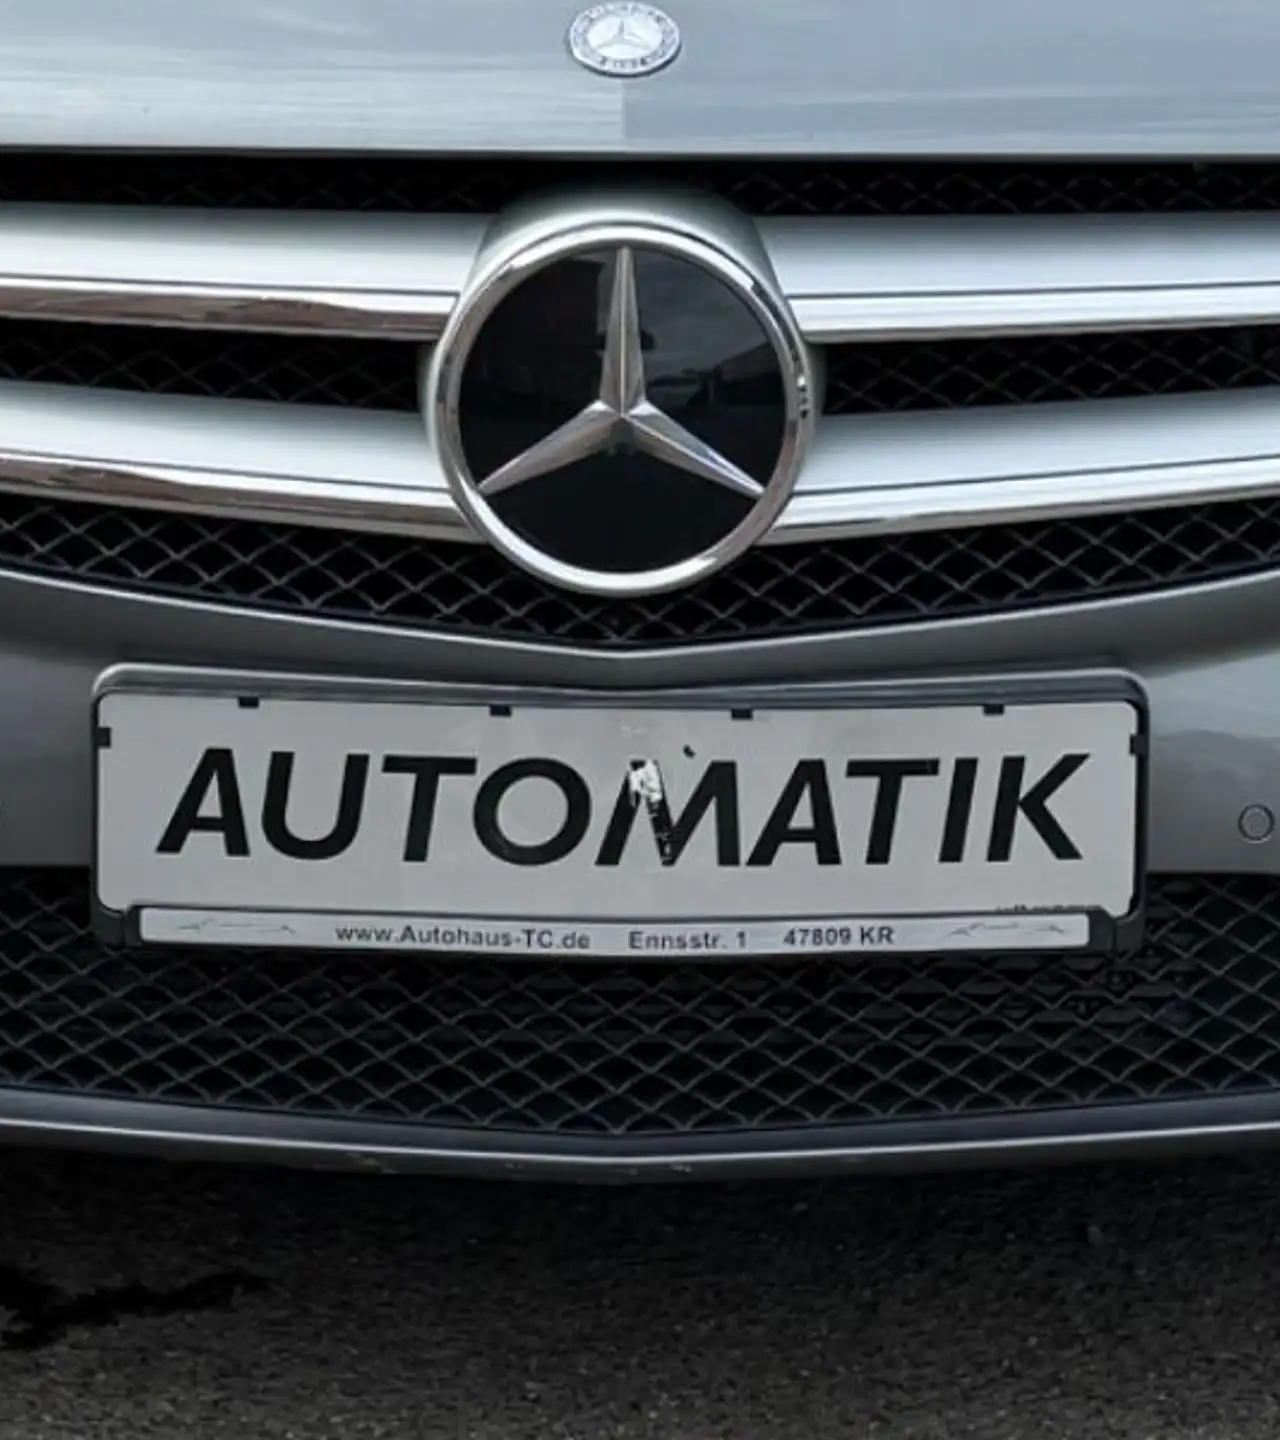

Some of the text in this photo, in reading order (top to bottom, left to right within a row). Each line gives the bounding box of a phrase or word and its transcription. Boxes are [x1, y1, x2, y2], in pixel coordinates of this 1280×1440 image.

[156, 747, 1091, 867] AUTOMATIK
[335, 924, 894, 951] www.Autohaus-TC.de Ennsstr. 1 47809 KR
